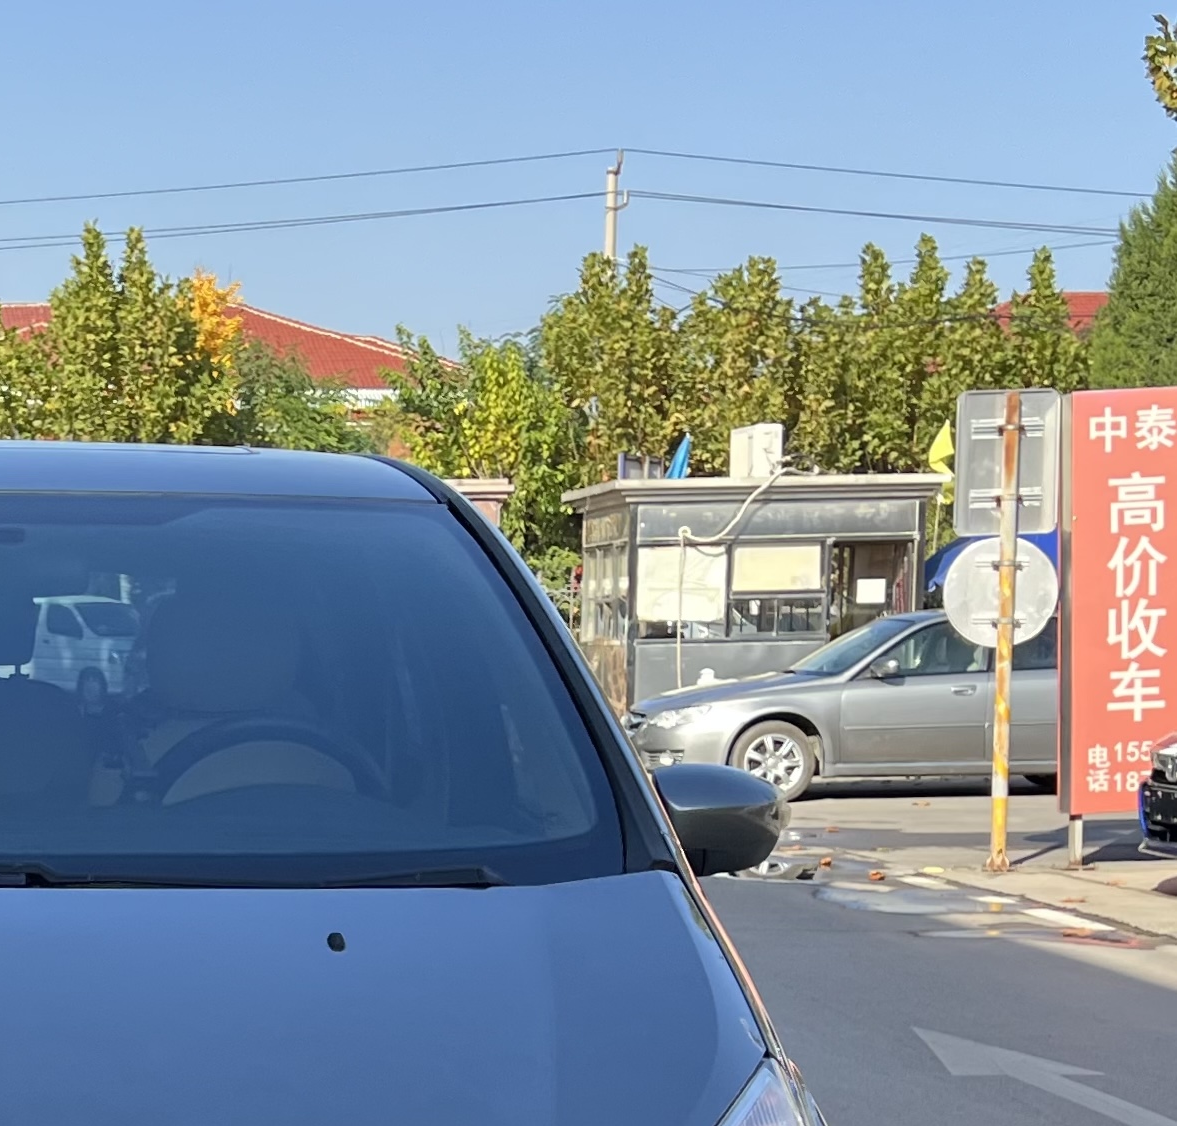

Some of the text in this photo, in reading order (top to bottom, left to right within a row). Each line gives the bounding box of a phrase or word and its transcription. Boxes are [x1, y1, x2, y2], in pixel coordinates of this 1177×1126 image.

[1088, 404, 1176, 453] 中泰
[1107, 471, 1167, 722] 高价收车
[1086, 743, 1111, 793] 电话
[1113, 770, 1151, 793] 18
